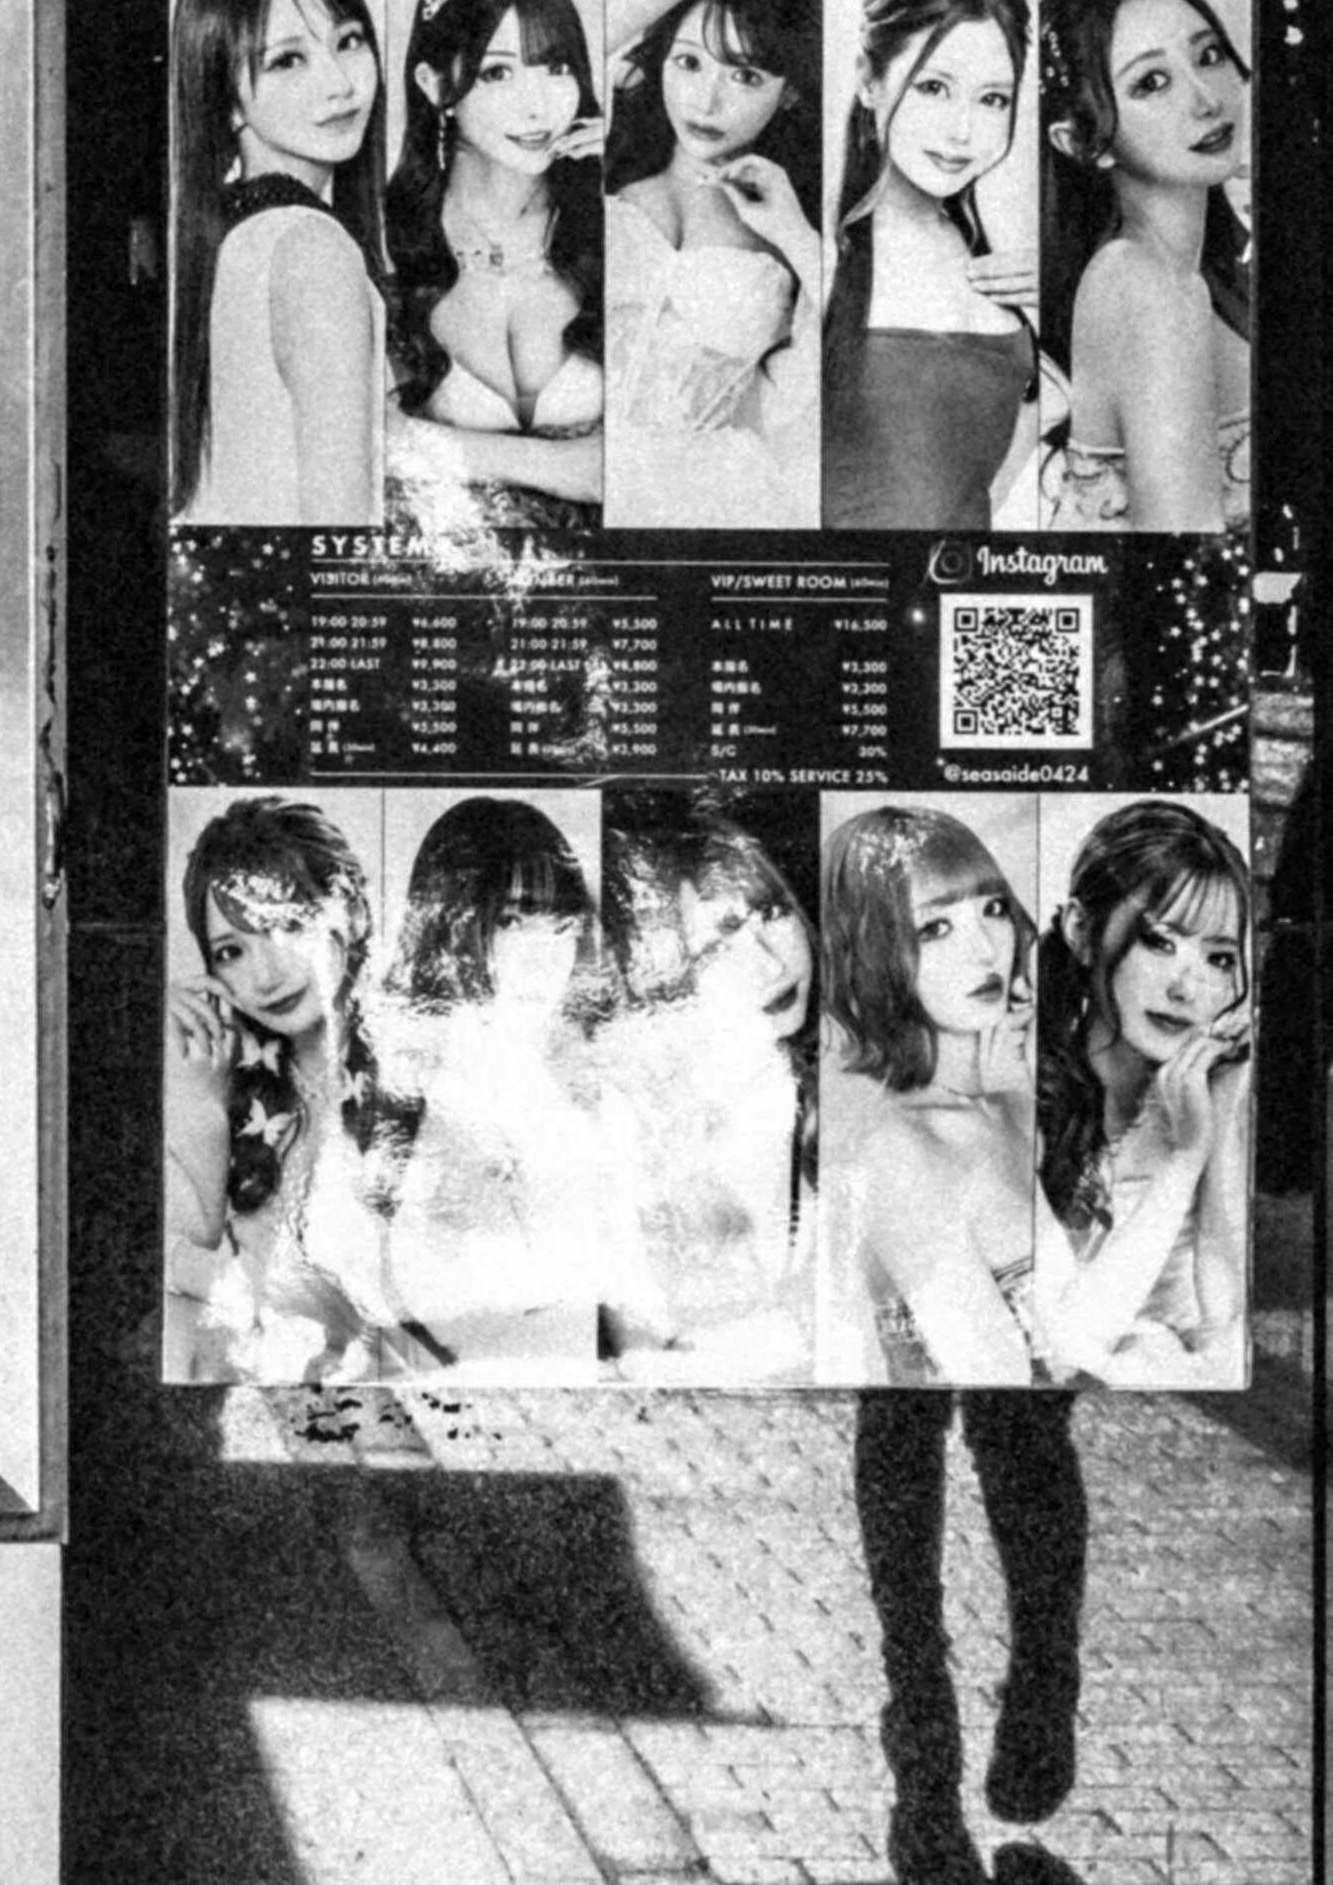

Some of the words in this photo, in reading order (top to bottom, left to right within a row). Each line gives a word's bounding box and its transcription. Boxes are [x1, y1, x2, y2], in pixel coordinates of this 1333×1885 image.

[312, 535, 430, 556] SYSTEM
[976, 545, 1109, 586] Instagram
[310, 571, 370, 586] VISITOR
[711, 574, 793, 591] VIP/SWEET
[797, 574, 847, 589] ROOM
[710, 617, 742, 632] ALL
[749, 617, 794, 632] TIME
[350, 657, 381, 671] LAST
[718, 768, 748, 784] TAX
[753, 768, 786, 784] 10%
[789, 768, 851, 784] SERVICE
[855, 768, 889, 784] 25%
[943, 763, 1090, 785] @seasaide0424
